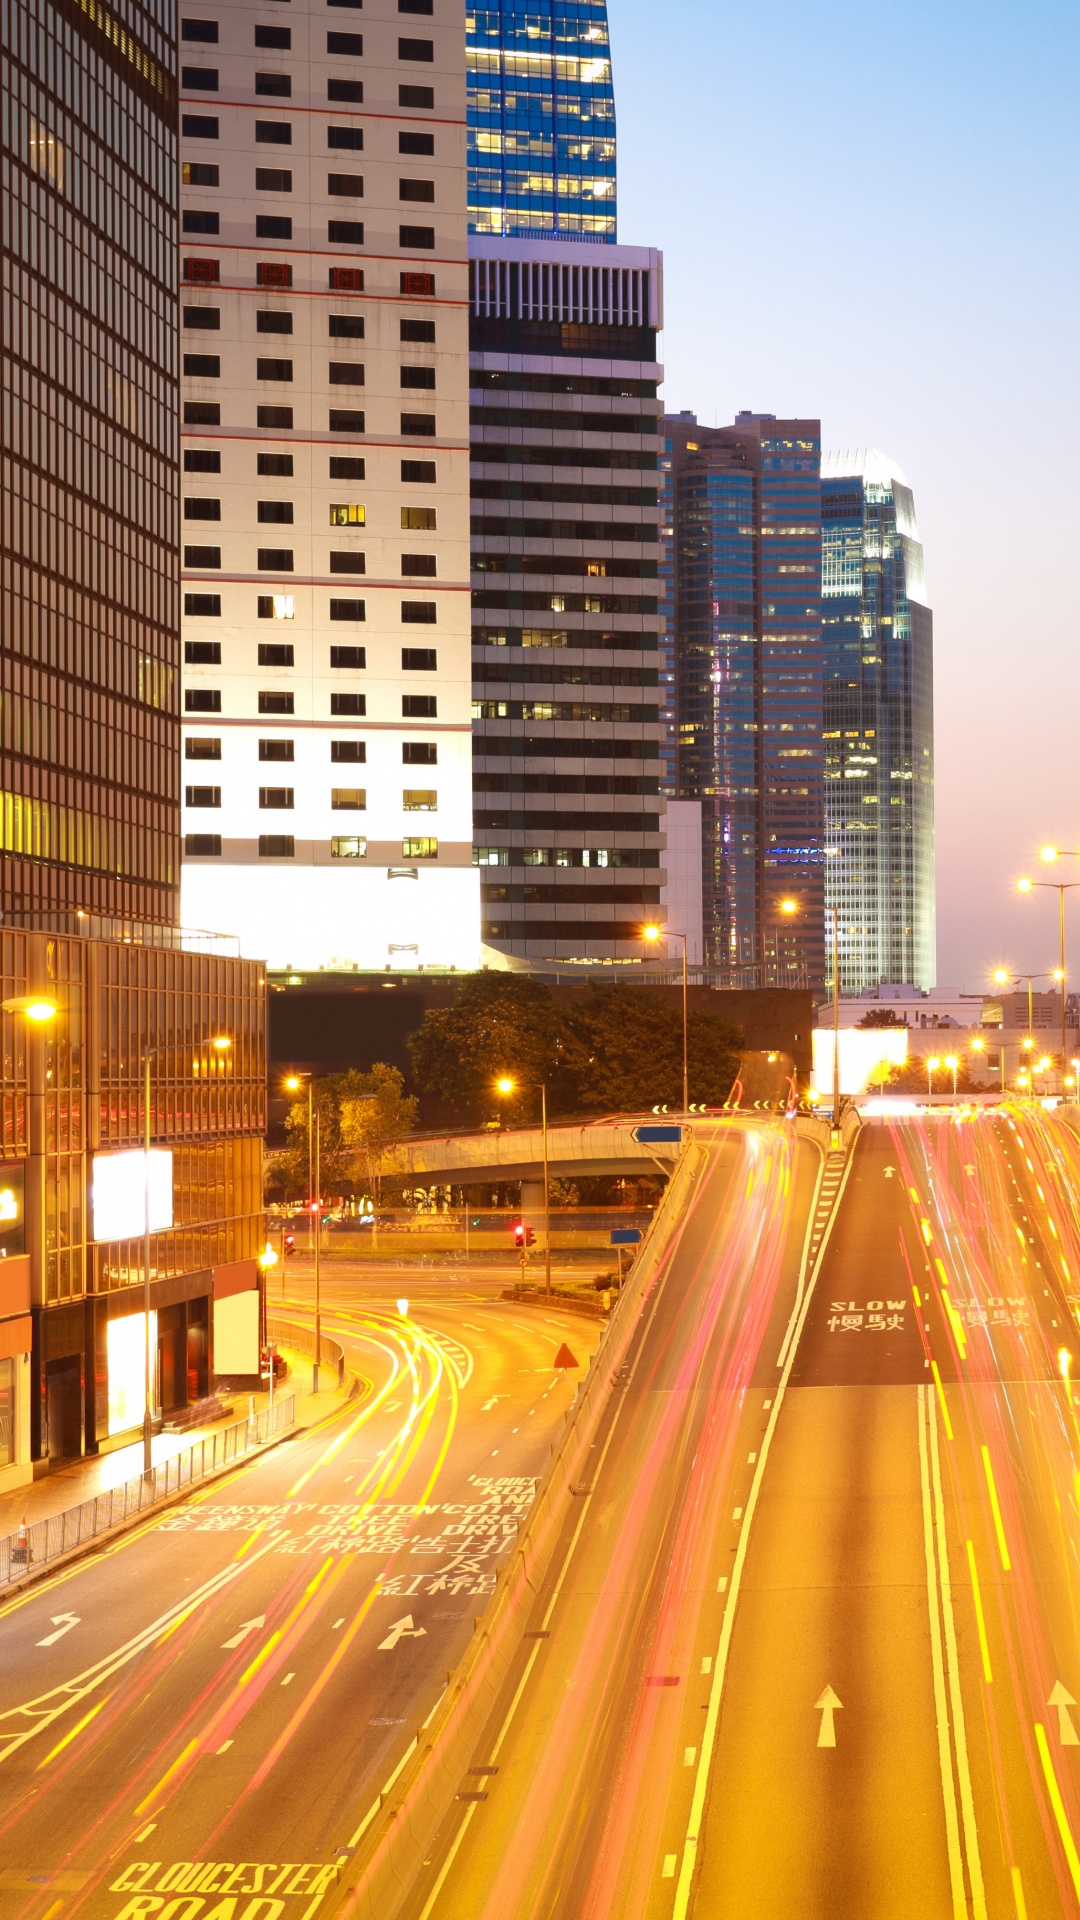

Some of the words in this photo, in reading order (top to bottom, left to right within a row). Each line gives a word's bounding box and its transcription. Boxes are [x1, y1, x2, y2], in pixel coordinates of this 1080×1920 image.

[830, 1300, 906, 1311] SLOW
[952, 1297, 1026, 1308] SLOW
[827, 1314, 904, 1332] 慢駛
[318, 1505, 441, 1514] COTTON
[328, 1515, 413, 1525] TREE
[460, 1514, 527, 1524] TRE
[304, 1525, 410, 1535] DRIVE
[273, 1535, 410, 1554] 紅棉路
[434, 1554, 490, 1573] 及
[108, 1862, 343, 1894] GLOUCESTER
[114, 1895, 285, 1920] ROAD
